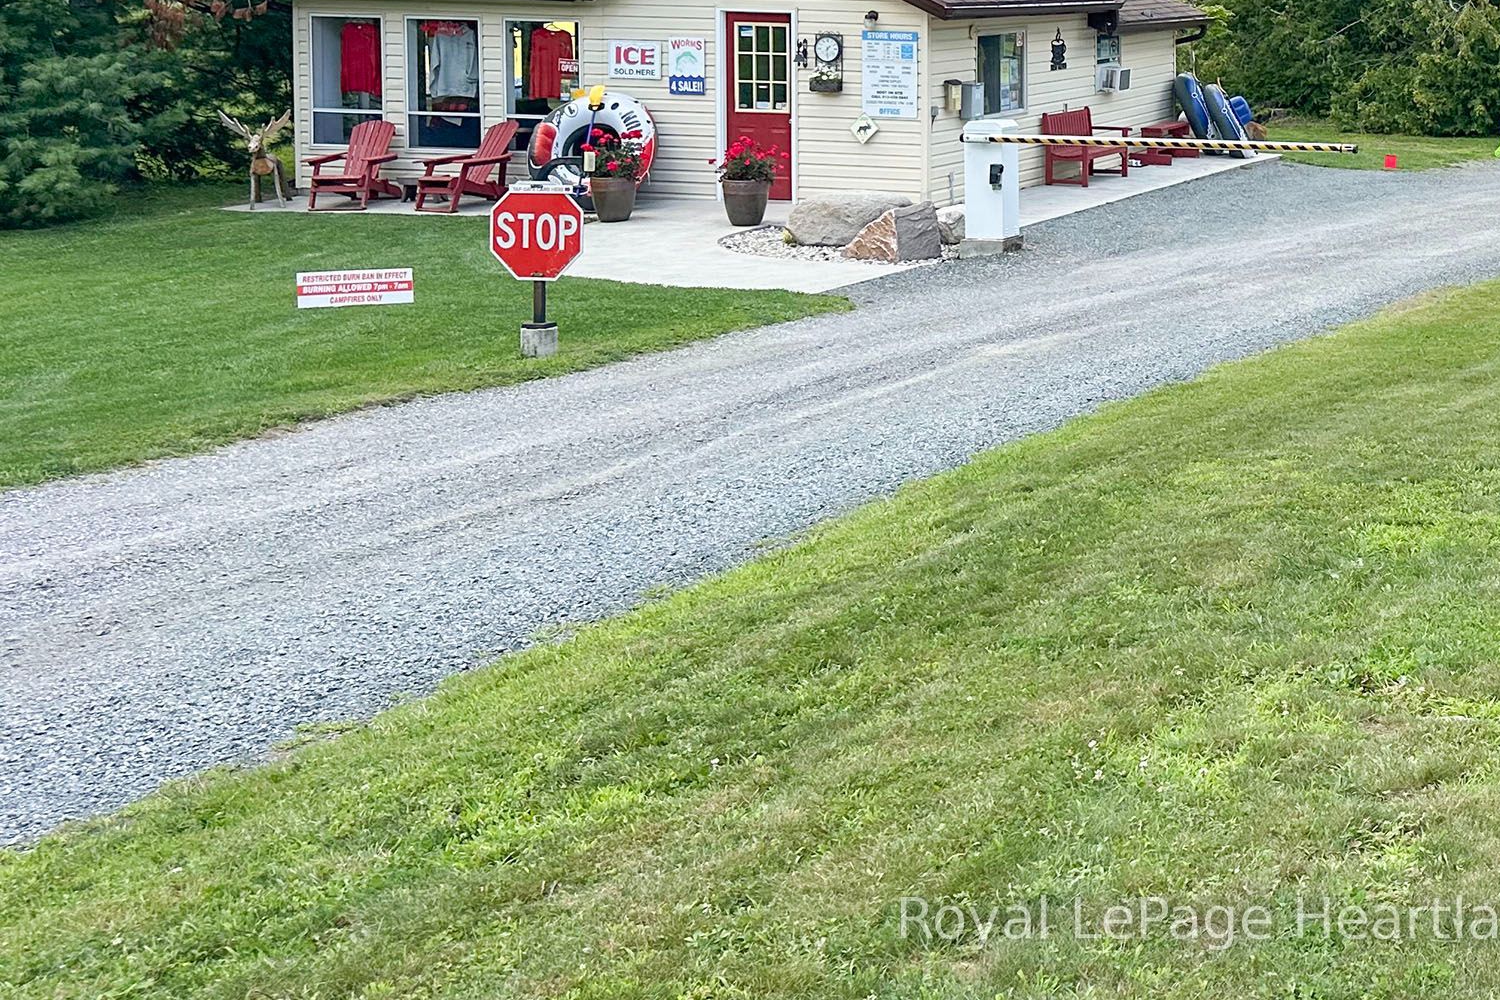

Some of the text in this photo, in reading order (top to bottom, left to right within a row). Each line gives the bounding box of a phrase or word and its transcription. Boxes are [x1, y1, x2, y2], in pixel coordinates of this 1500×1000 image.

[867, 32, 913, 41] STORE HOURS
[671, 39, 703, 50] WORMS
[615, 45, 655, 65] ICE
[671, 82, 676, 91] 4
[496, 211, 578, 251] STOP
[302, 274, 341, 283] RESTRICTED
[343, 273, 361, 281] BURN
[384, 271, 408, 279] EFFECT
[302, 285, 337, 294] BURNING
[337, 283, 373, 293] ALLOWED
[329, 294, 383, 304] CAMPFIRES ONLY
